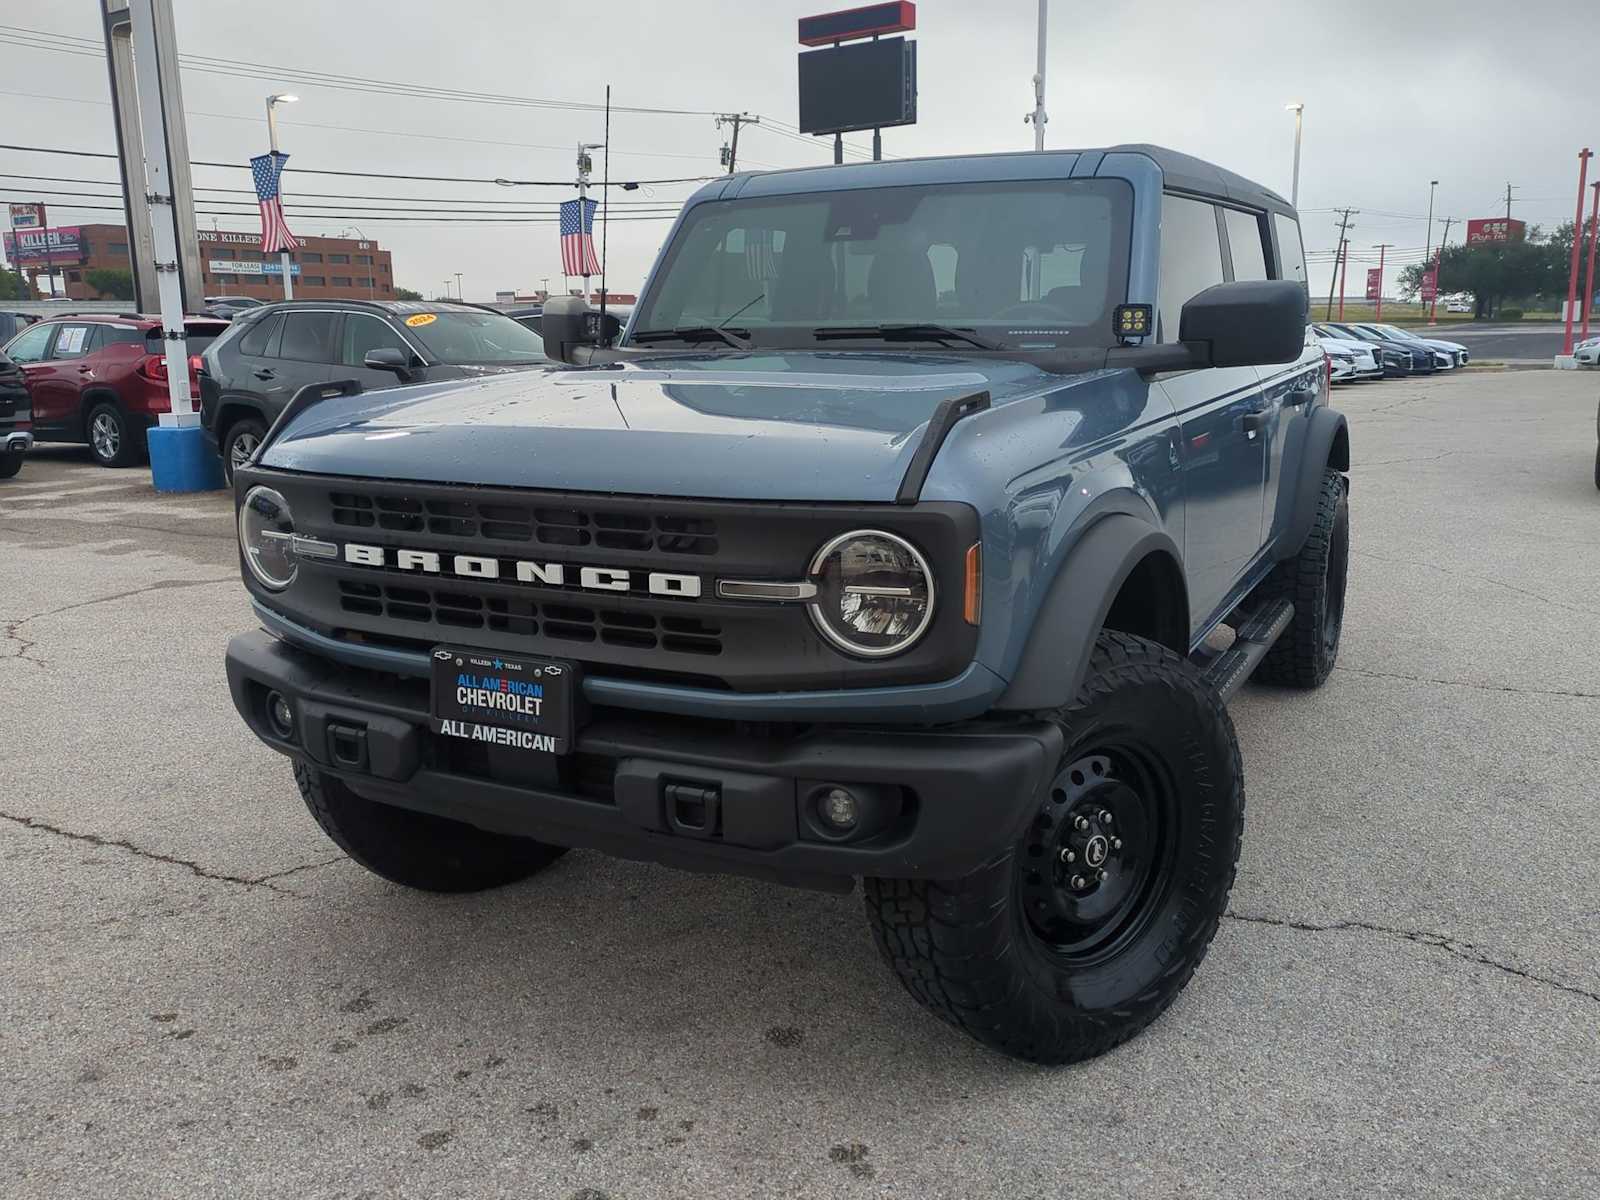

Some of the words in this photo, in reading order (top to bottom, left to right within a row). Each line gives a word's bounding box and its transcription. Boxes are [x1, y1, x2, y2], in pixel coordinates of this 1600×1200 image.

[345, 543, 701, 597] BRONCO
[504, 662, 522, 671] TEXAS
[457, 673, 480, 689] ALL
[482, 677, 543, 698] AMERICAN
[456, 686, 543, 716] CHEVROLET
[440, 719, 469, 737] ALL
[471, 724, 556, 753] AMERICAN
